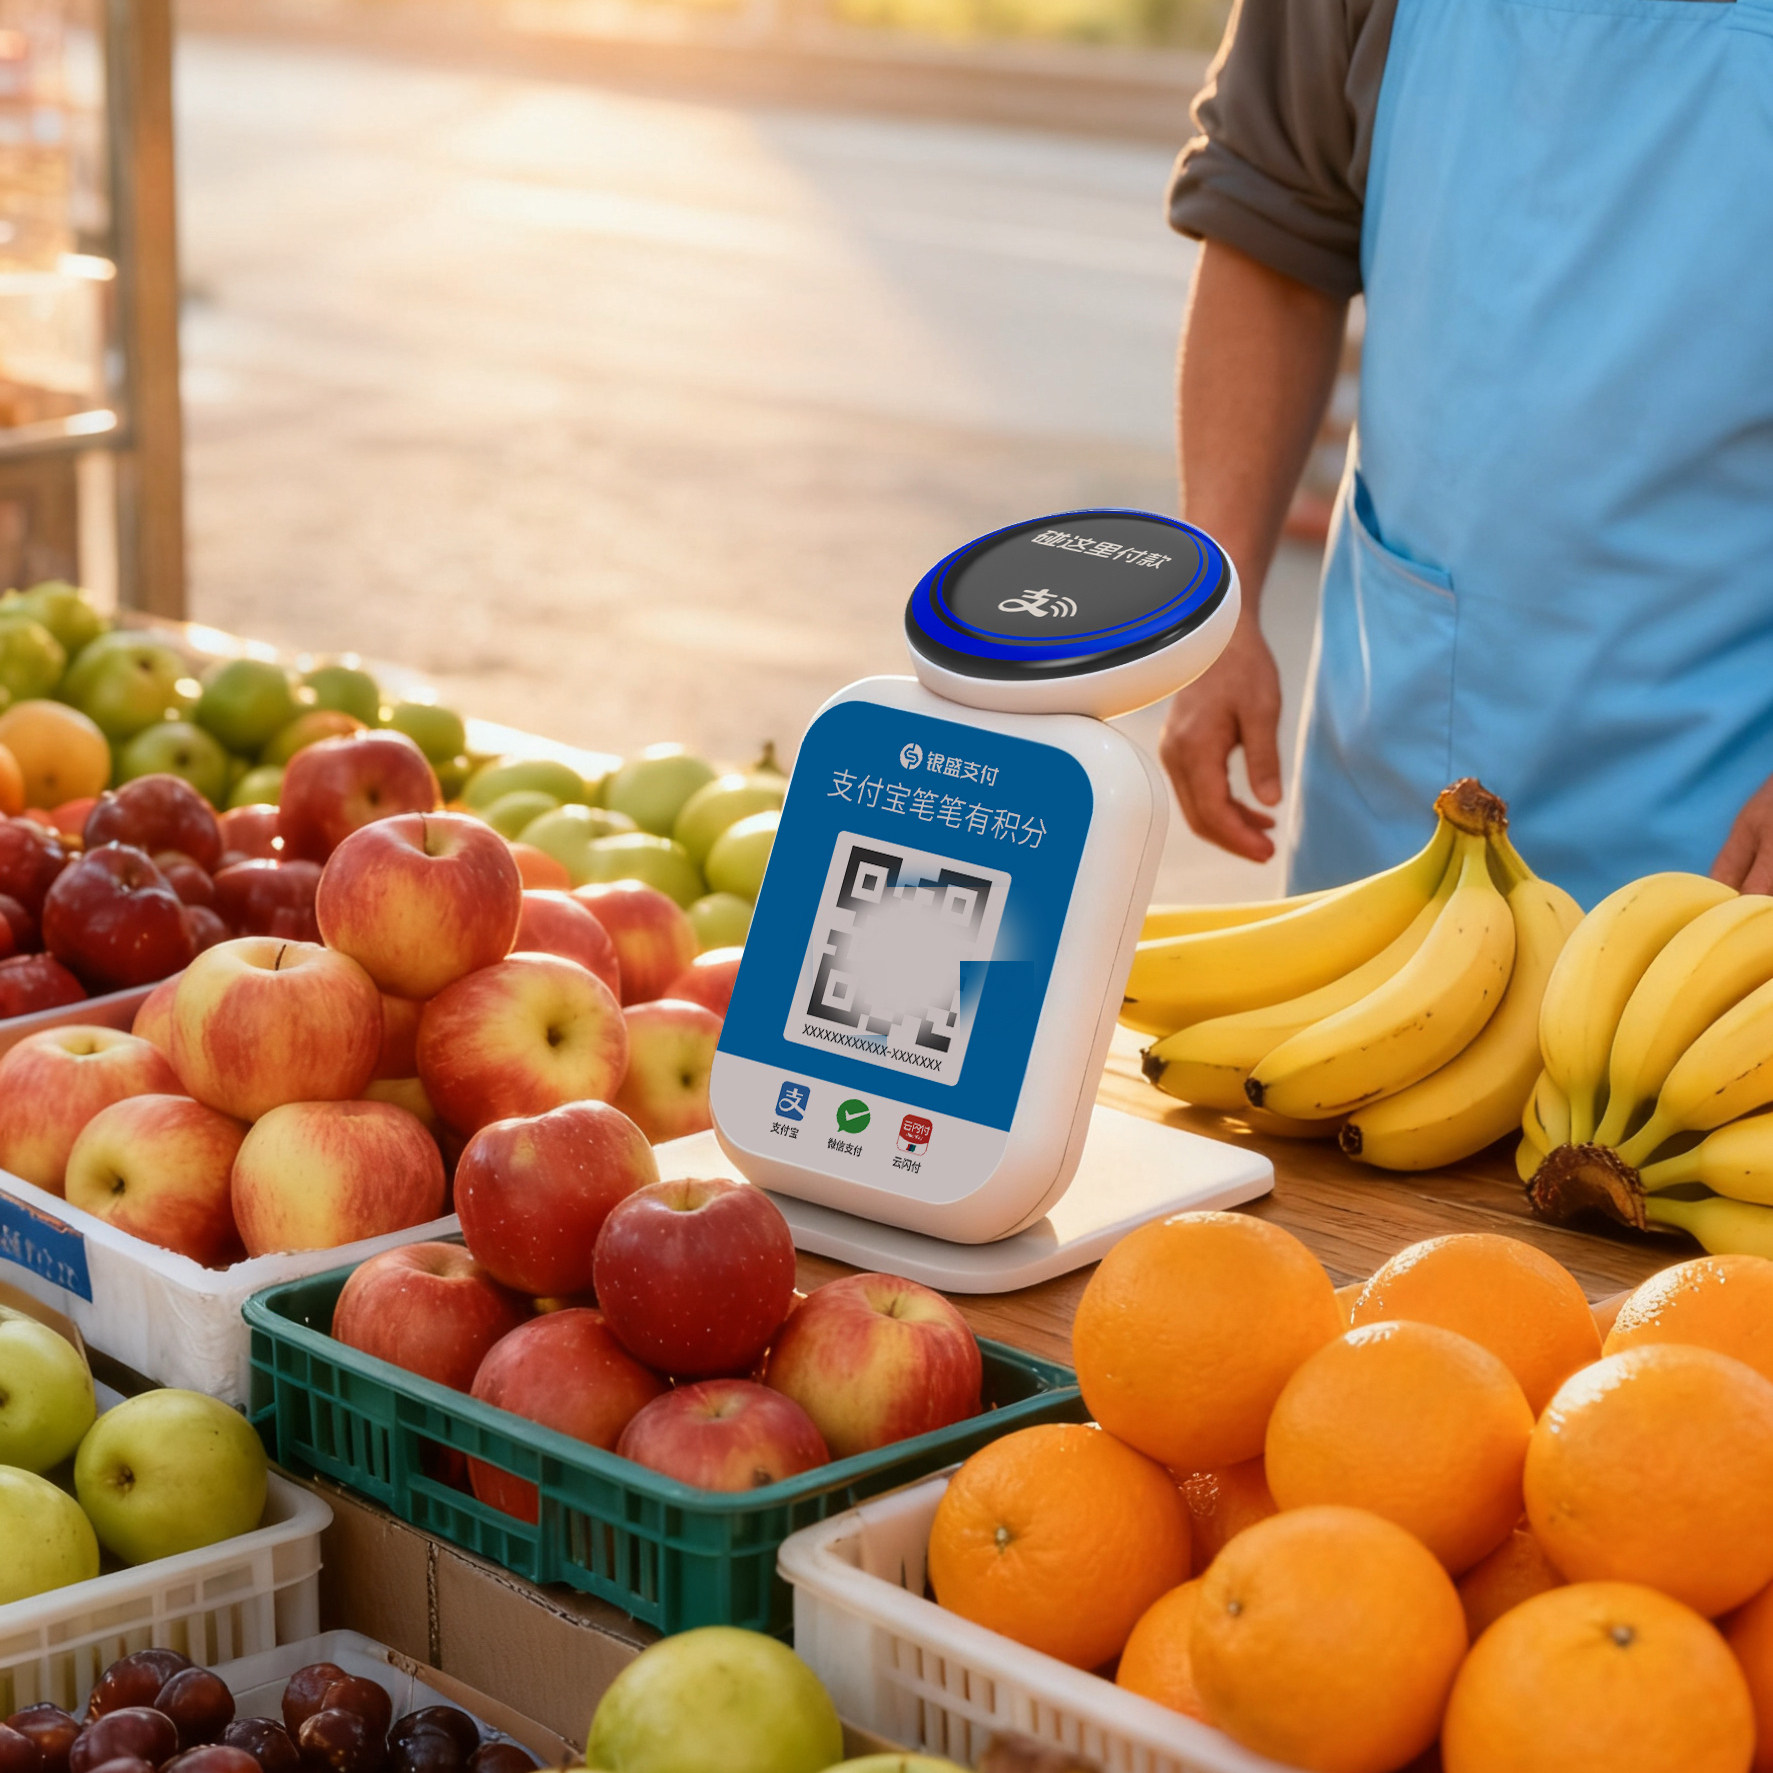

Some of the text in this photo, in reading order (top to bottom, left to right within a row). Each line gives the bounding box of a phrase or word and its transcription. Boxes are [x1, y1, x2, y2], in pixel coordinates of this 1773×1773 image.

[1031, 530, 1172, 569] 碰这里付款
[926, 751, 1000, 787] 银盛支付
[827, 769, 1047, 849] 支付宝笔笔有积分
[770, 1122, 800, 1139] 支付宝
[827, 1137, 863, 1157] 微信支付
[892, 1156, 921, 1174] 云闪付
